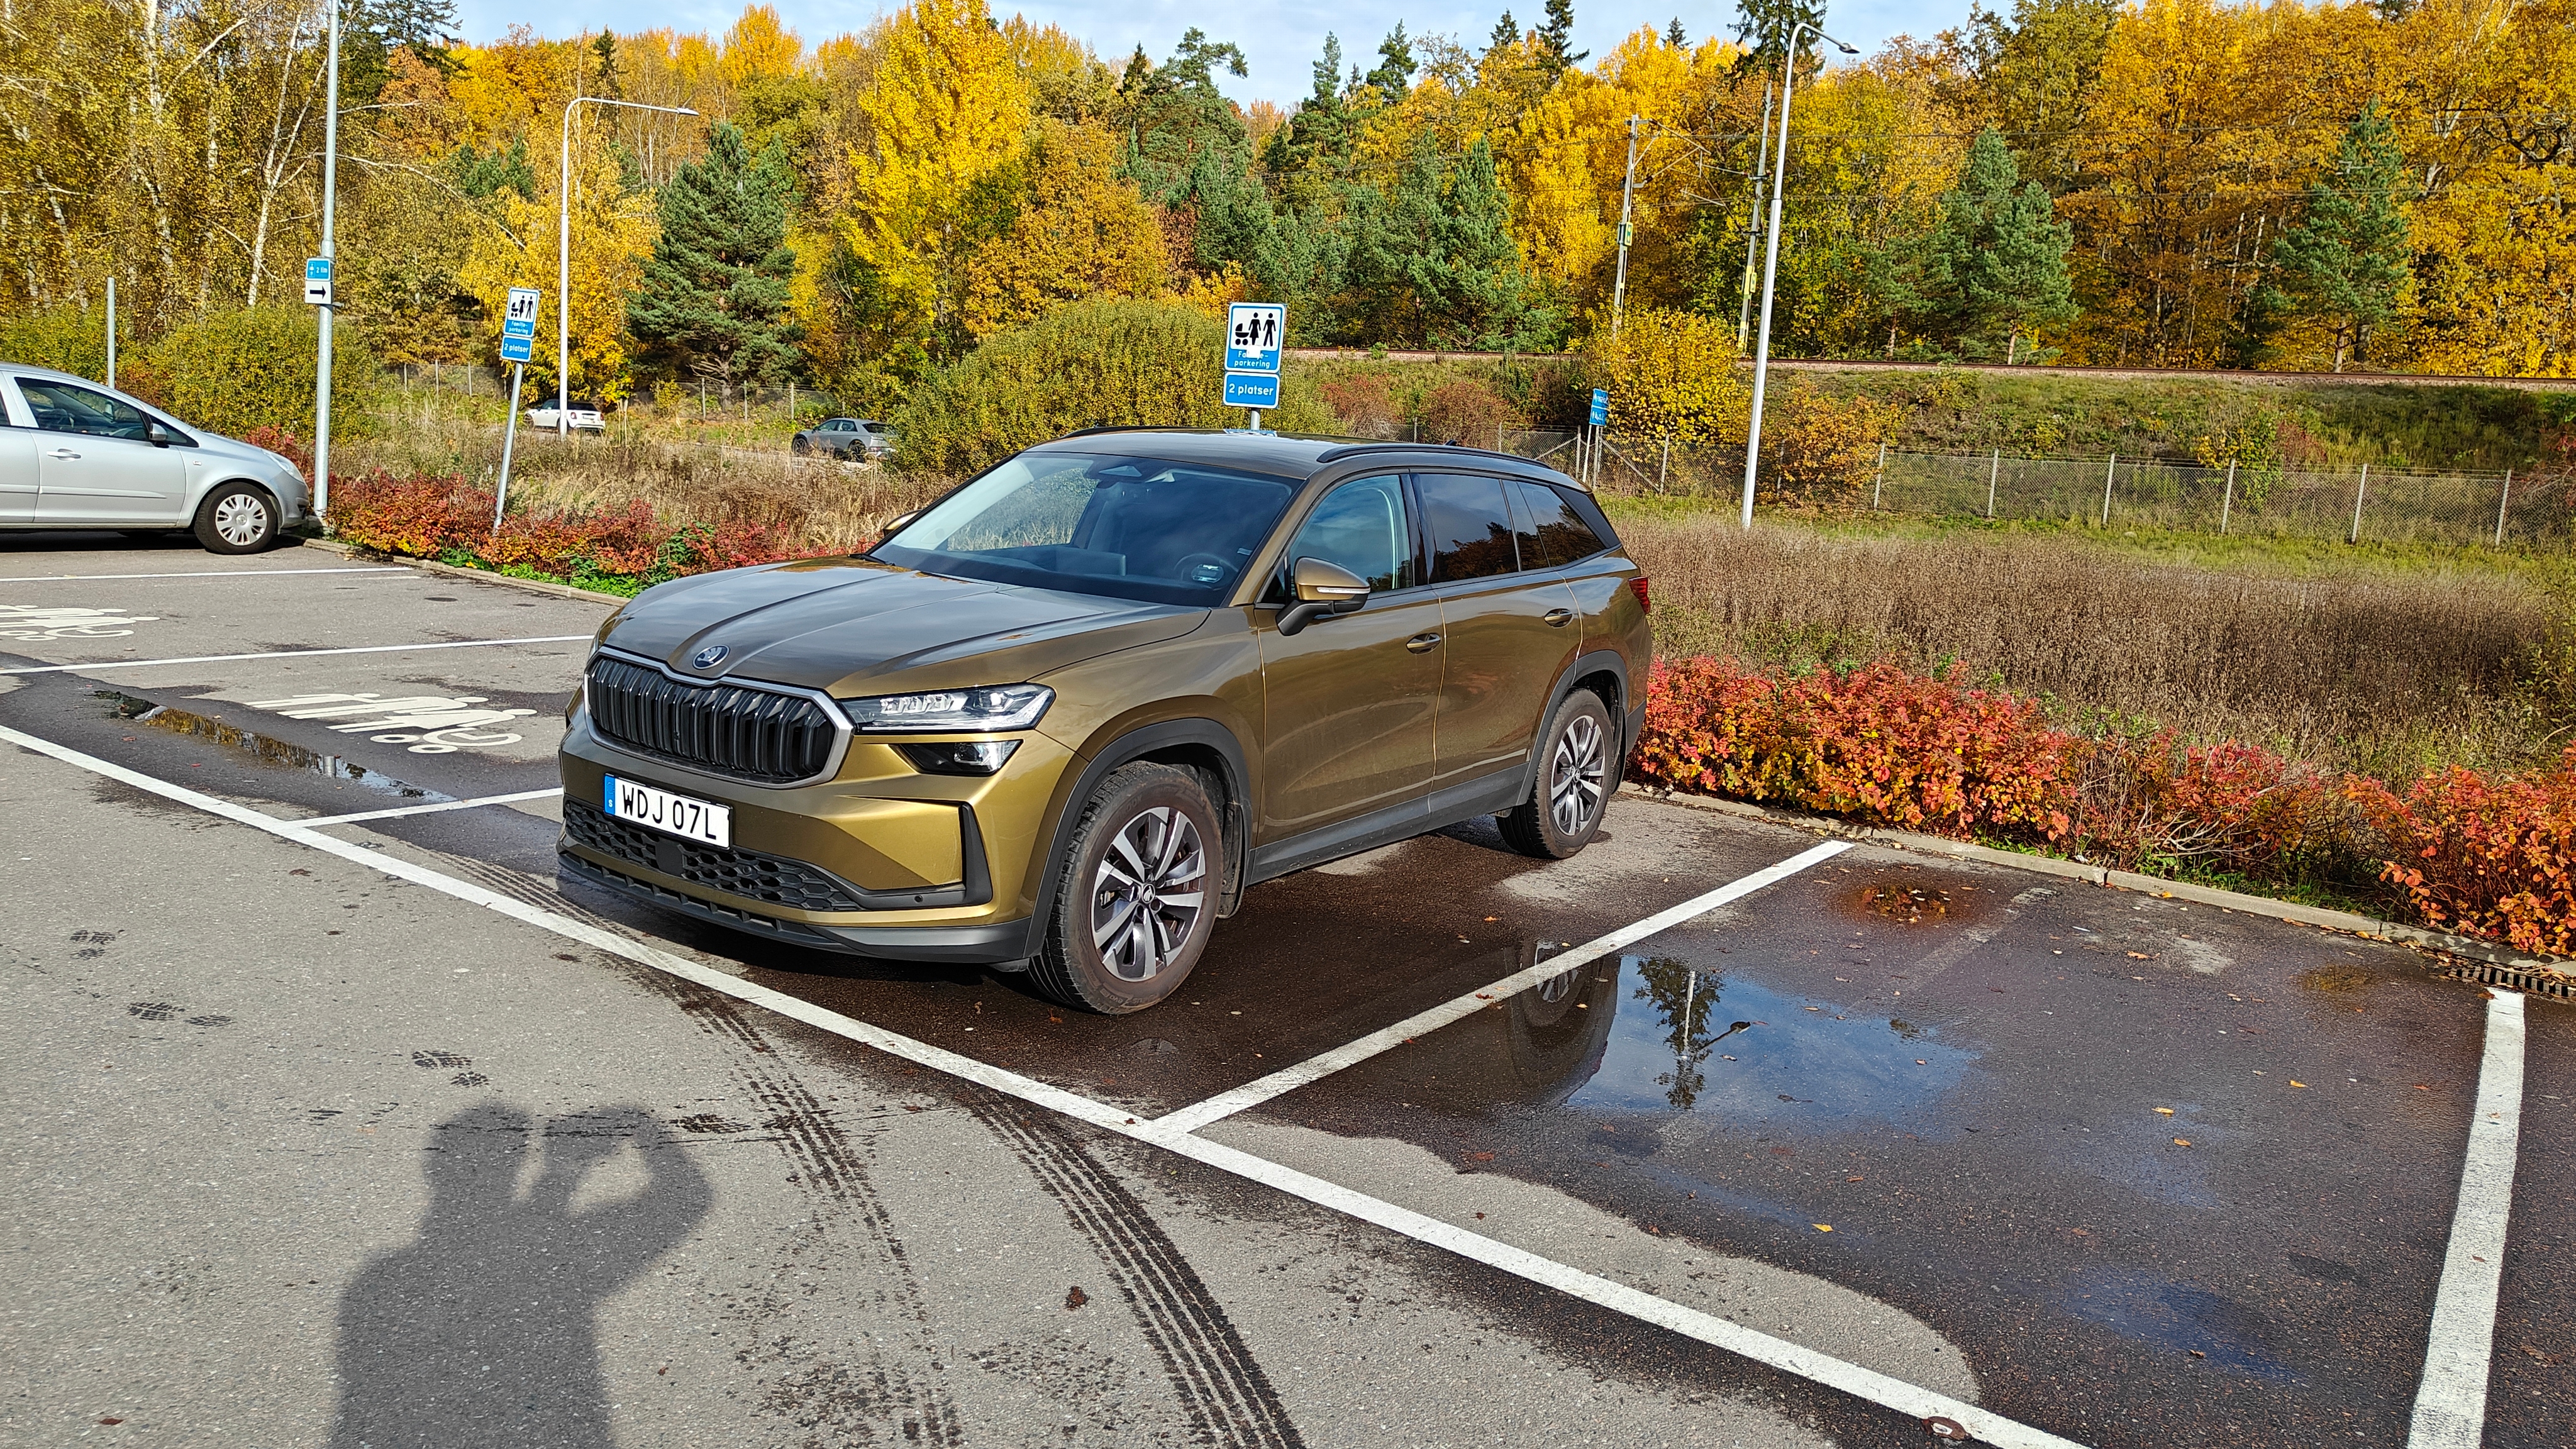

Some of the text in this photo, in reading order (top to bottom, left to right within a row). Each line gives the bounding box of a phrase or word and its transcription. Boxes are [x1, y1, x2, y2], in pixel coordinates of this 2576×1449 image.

[509, 344, 529, 353] platser
[1238, 350, 1269, 360] Fae-
[1234, 360, 1270, 369] parkering
[1228, 383, 1274, 396] 2 platser
[608, 799, 613, 808] S
[622, 784, 717, 840] WDJ 07L
